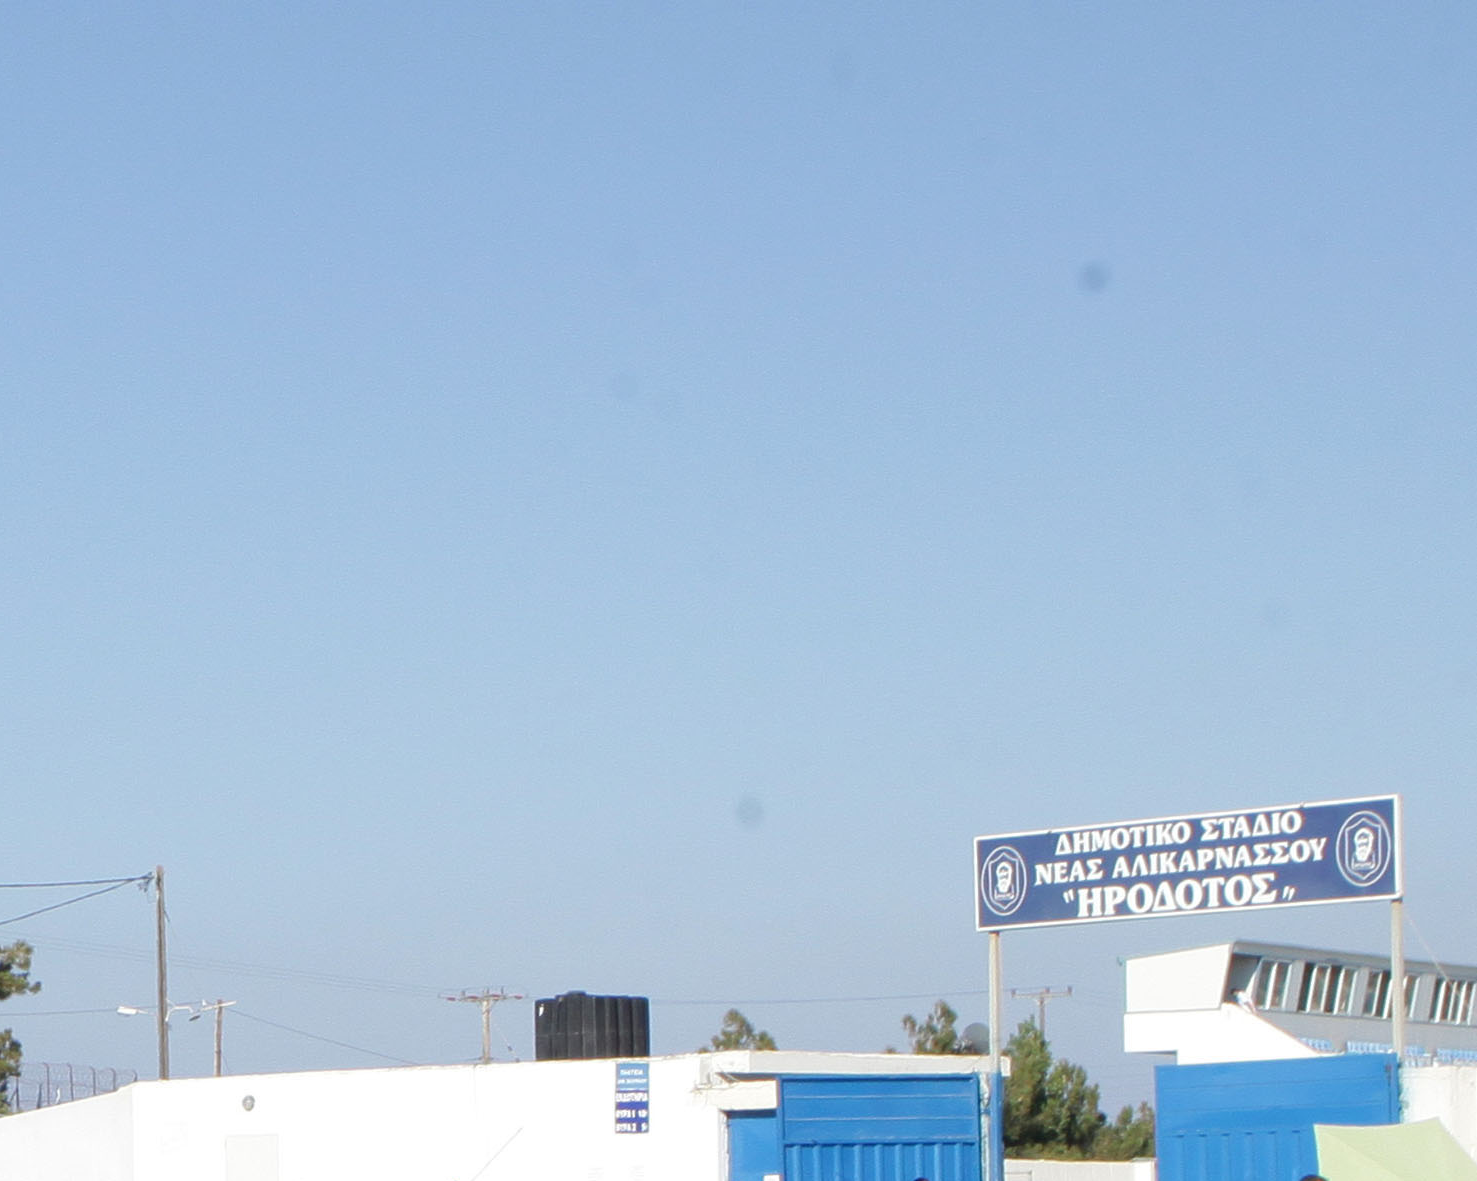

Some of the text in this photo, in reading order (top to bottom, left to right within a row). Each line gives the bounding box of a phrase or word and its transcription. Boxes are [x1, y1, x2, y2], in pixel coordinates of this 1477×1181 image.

[1054, 810, 1303, 856] ΔΗΜΟΤΙΚΟ ΣΤΑΔΙΟ
[1034, 837, 1328, 887] ΝΕΑΣ ΑΛΙΚΑΡΝΑΣΣΟΥ
